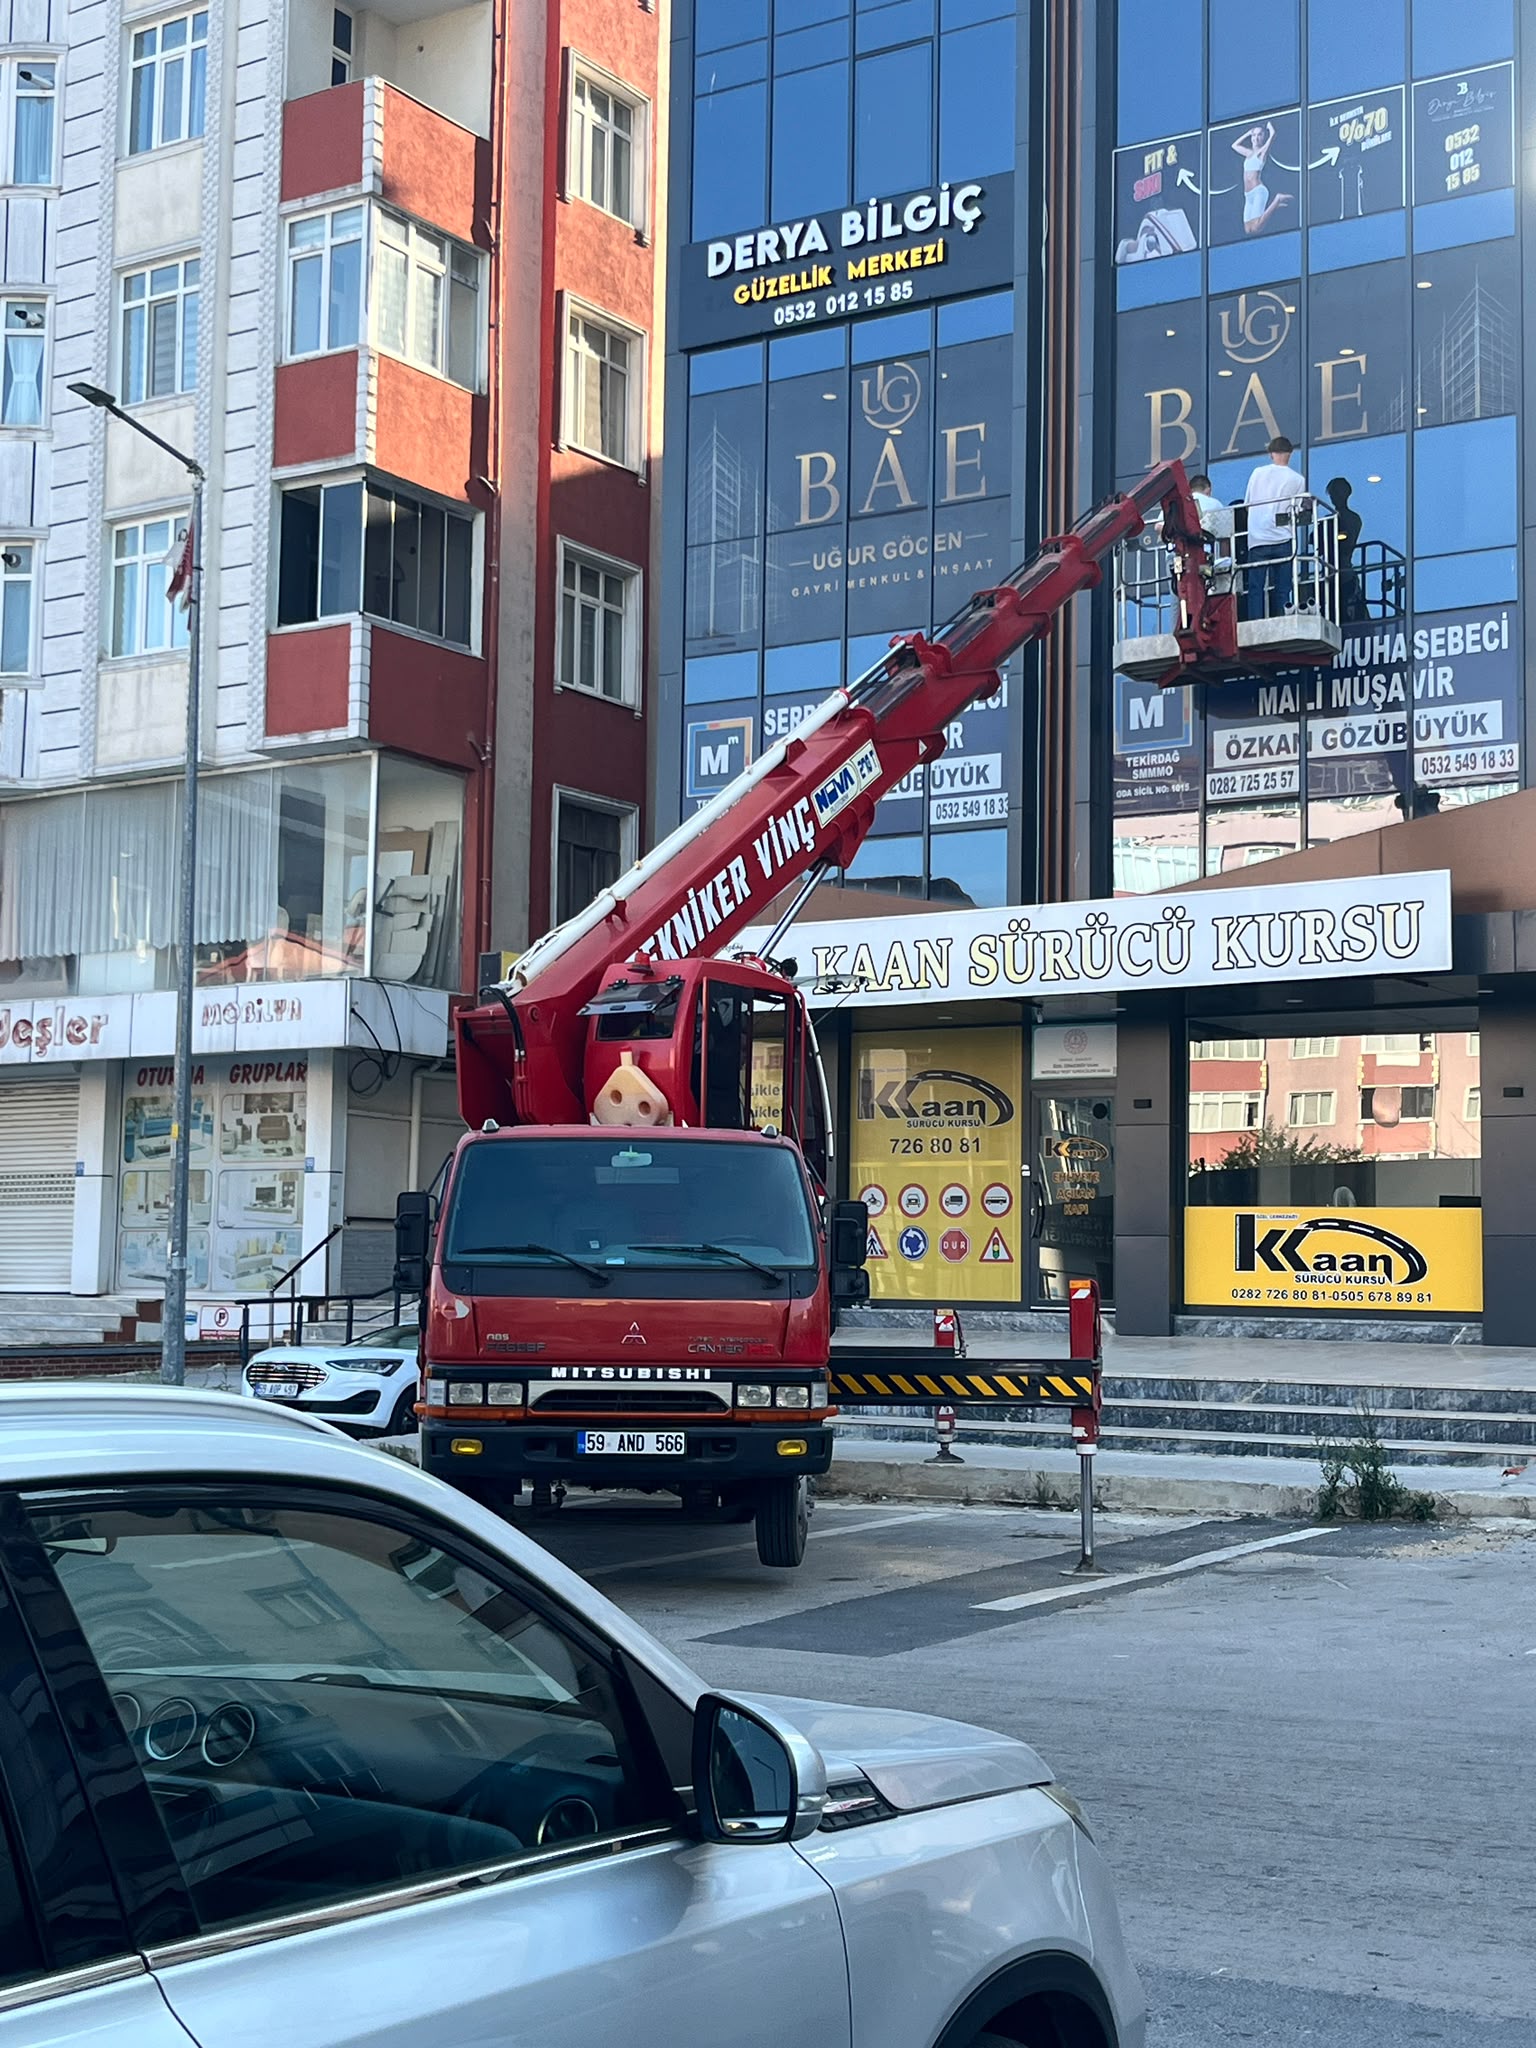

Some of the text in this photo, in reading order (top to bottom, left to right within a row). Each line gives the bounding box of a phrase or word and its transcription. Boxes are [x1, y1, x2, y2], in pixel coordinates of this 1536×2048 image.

[1339, 107, 1388, 146] %70
[1445, 124, 1480, 152] 0532
[1450, 147, 1474, 171] 012
[1446, 163, 1480, 192] 15 85
[707, 182, 982, 278] DERYA BİLGİÇ
[733, 238, 945, 305] GÜZELLİK MERKEZİ
[774, 281, 914, 326] 0532 012 15 85
[1144, 354, 1369, 469] BAE
[794, 422, 987, 527] BAE
[812, 545, 876, 571] UĞUR
[791, 559, 993, 598] GAYRİ MENKUL & İNŞAAT
[1333, 612, 1508, 669] MUHASEBECİ
[1331, 661, 1455, 711] MÜŞAVİR
[1225, 710, 1489, 761] ÖZKAN GÖZÜBÜYÜK
[1126, 750, 1181, 767] TEKİRDAĞ
[1422, 748, 1514, 775] 0532 549 18 33
[1132, 765, 1174, 780] SMMMO
[1209, 770, 1294, 795] 0282 725 25 57
[1134, 785, 1154, 797] SİCİL
[936, 803, 960, 820] 0532
[962, 800, 980, 817] 549
[984, 798, 995, 815] 18
[752, 796, 816, 880] VİNÇ
[812, 900, 1425, 995] KAAN SÜRÜCÜ KURSU
[947, 1118, 982, 1128] KURSU
[890, 1137, 980, 1154] 726 80 81
[1064, 1204, 1089, 1215] KAPI
[943, 1241, 966, 1250] DUR
[1294, 1273, 1386, 1285] SÜRÜCÜ KURSU
[1231, 1288, 1261, 1299] 0282
[1266, 1289, 1288, 1300] 726
[1292, 1289, 1308, 1300] 80
[1368, 1291, 1392, 1302] 678
[1396, 1291, 1412, 1302] 89
[1416, 1292, 1432, 1303] 81
[486, 1333, 510, 1341] ABS
[687, 1344, 744, 1354] CANTER
[551, 1367, 712, 1380] MITSUBISHI
[587, 1434, 605, 1451] 59
[617, 1434, 645, 1452] AND
[656, 1434, 683, 1452] 566
